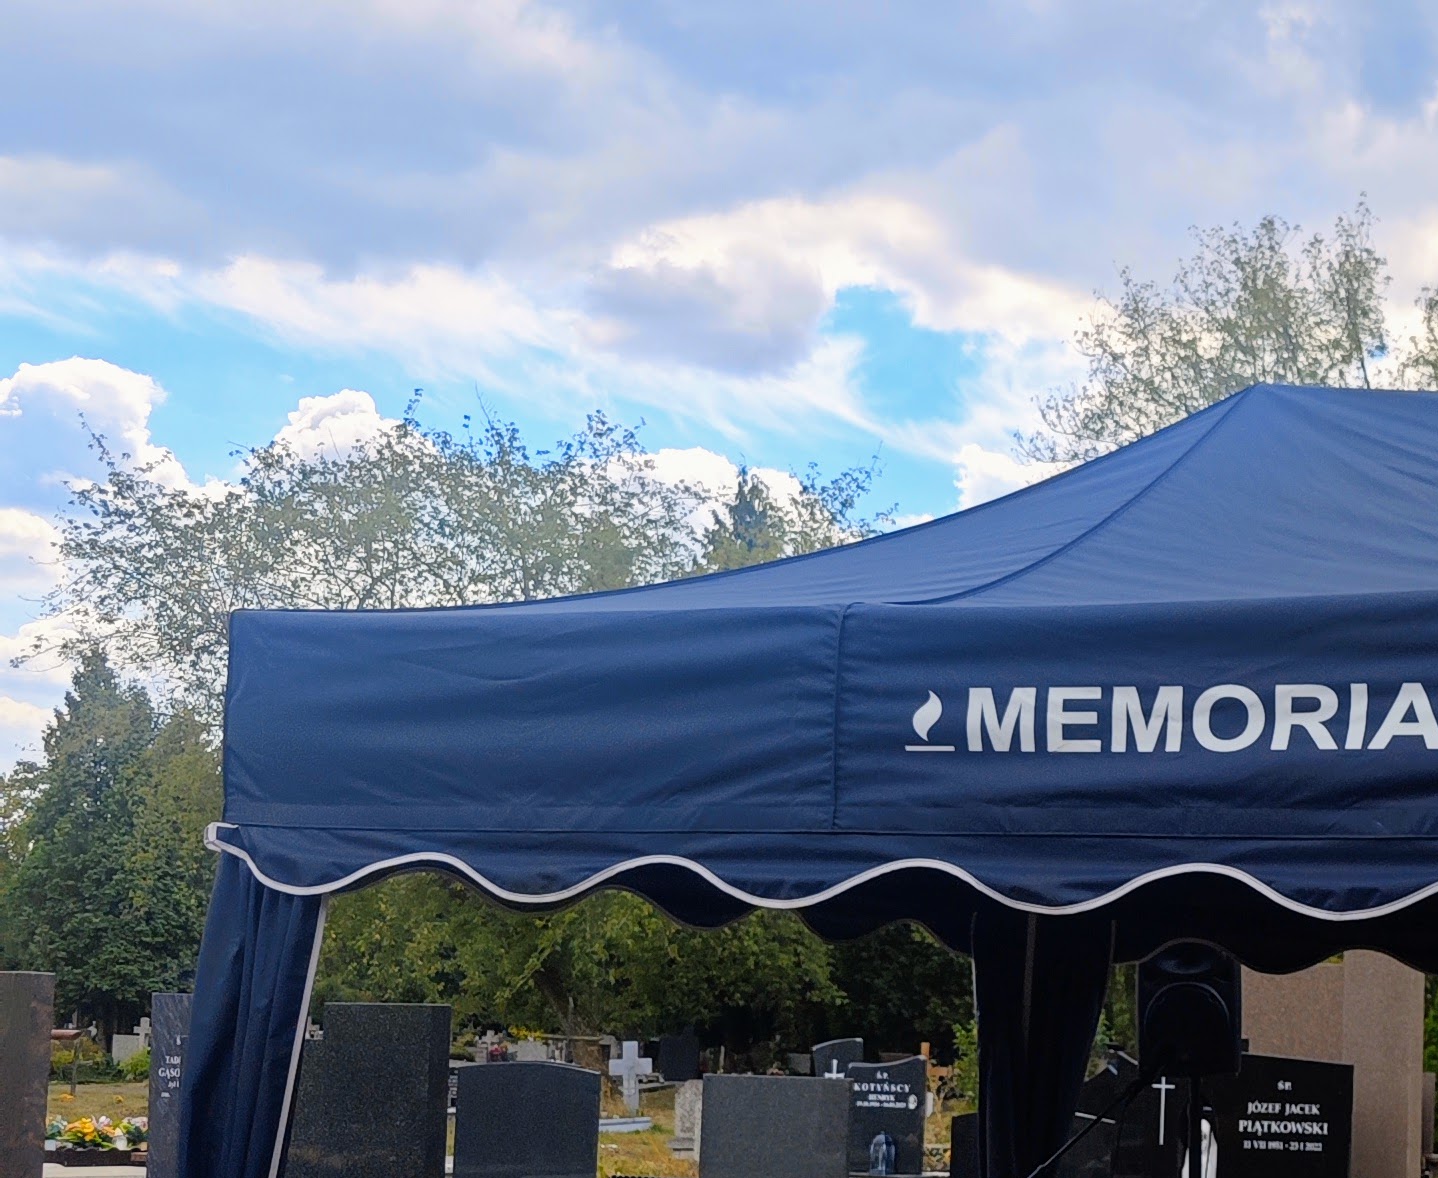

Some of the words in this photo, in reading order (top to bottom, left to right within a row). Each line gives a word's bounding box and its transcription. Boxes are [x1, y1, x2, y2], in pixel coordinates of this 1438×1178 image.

[1247, 1100, 1281, 1115] JÓZEF
[1284, 1103, 1320, 1116] JACEK
[1238, 1119, 1328, 1136] PIĄTKOWSKI
